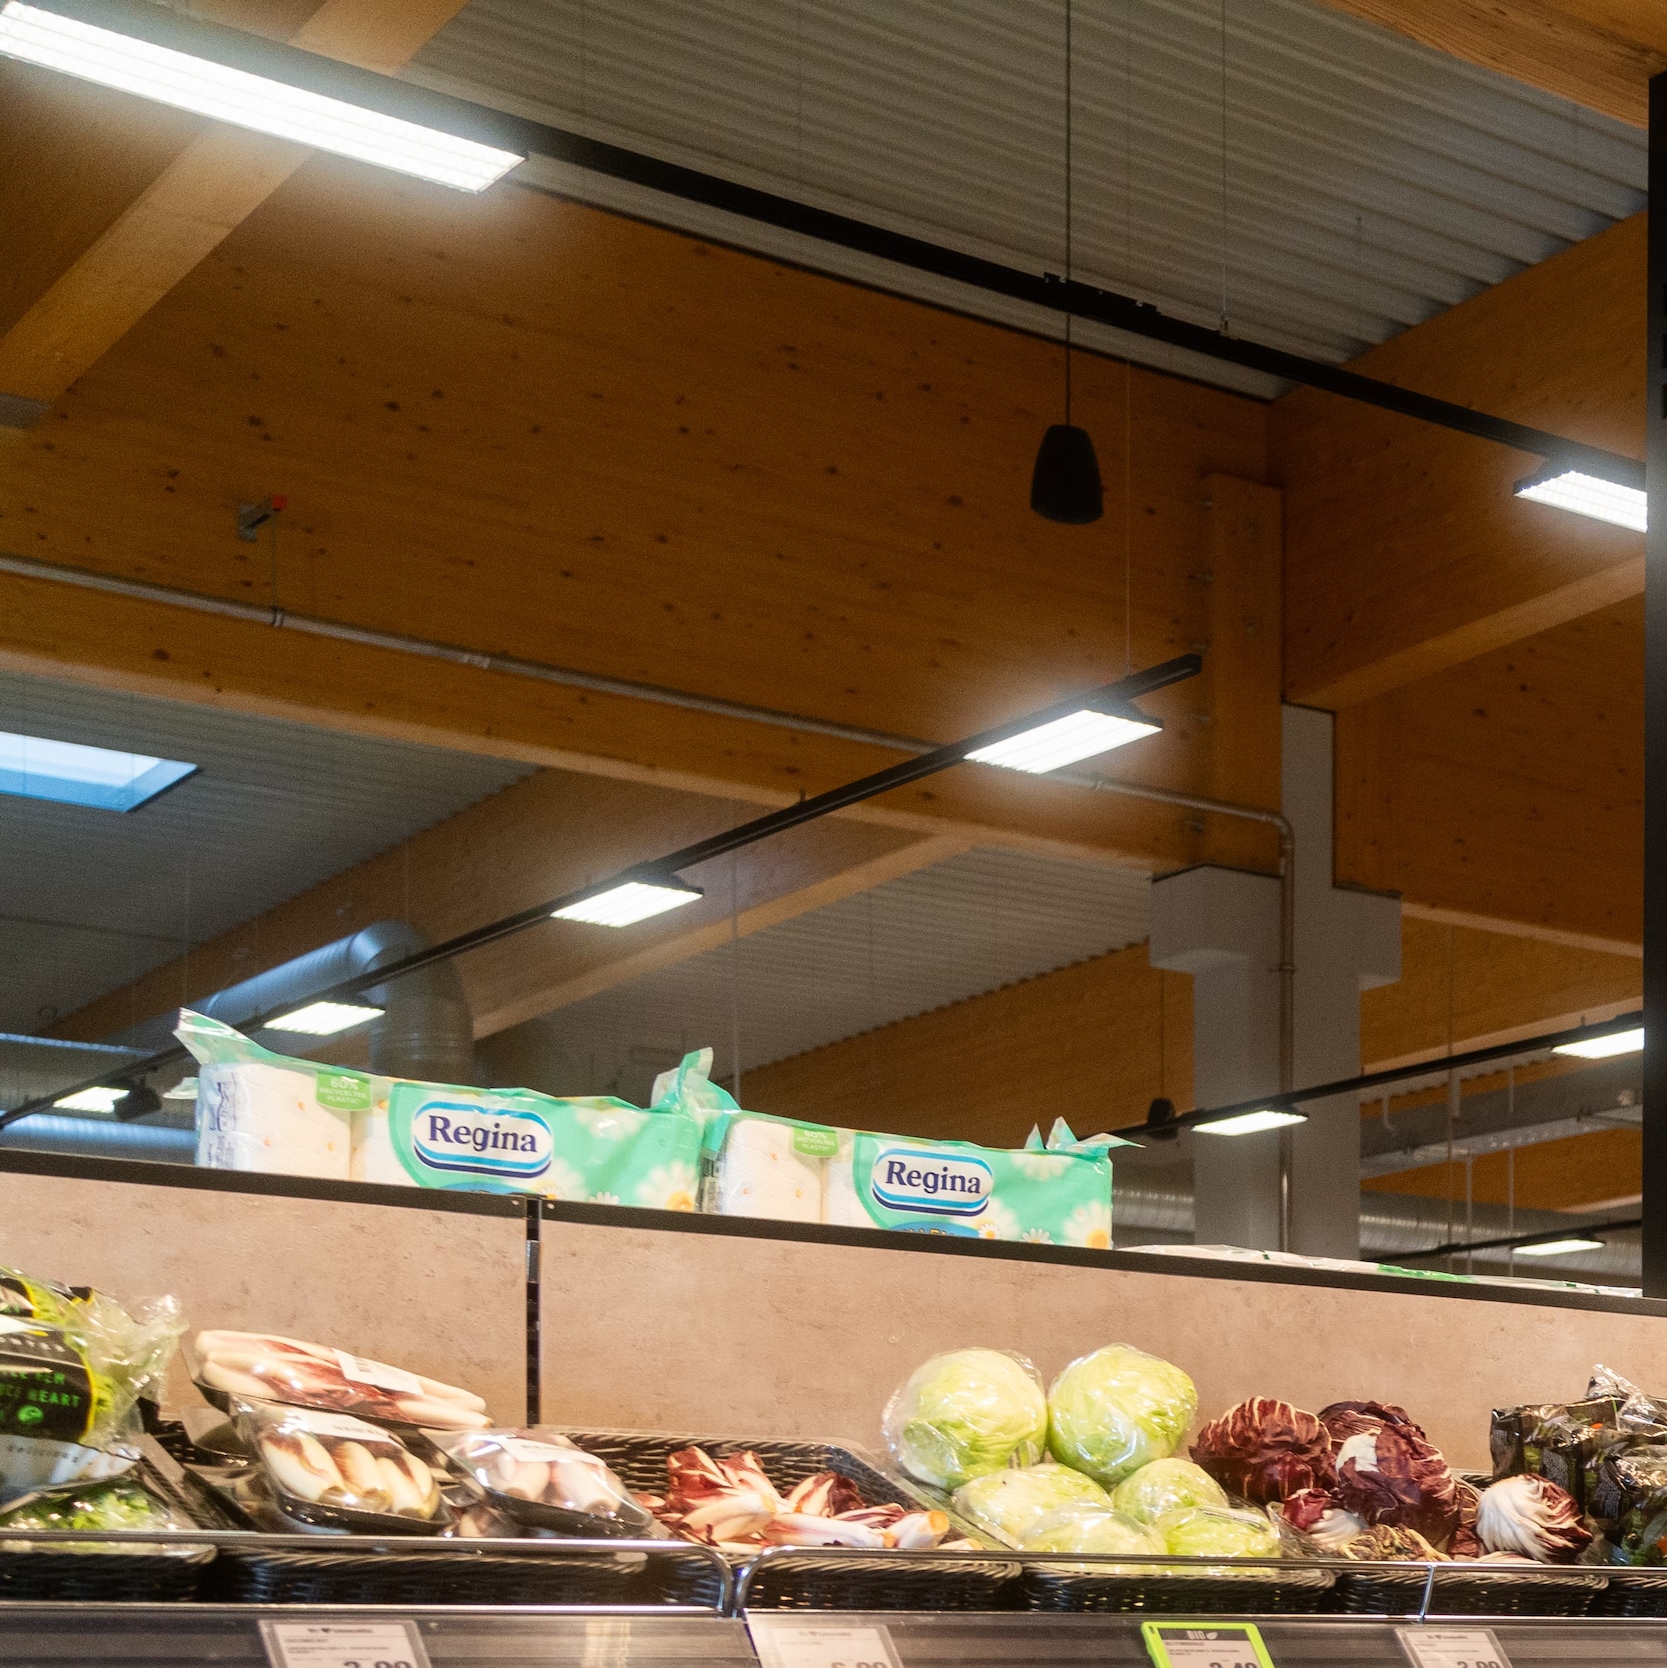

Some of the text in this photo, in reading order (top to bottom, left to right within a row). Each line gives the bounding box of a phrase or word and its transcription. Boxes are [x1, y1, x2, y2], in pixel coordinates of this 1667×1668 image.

[428, 1115, 538, 1153] Regina
[885, 1160, 982, 1195] Regina
[1186, 1630, 1206, 1640] BIO
